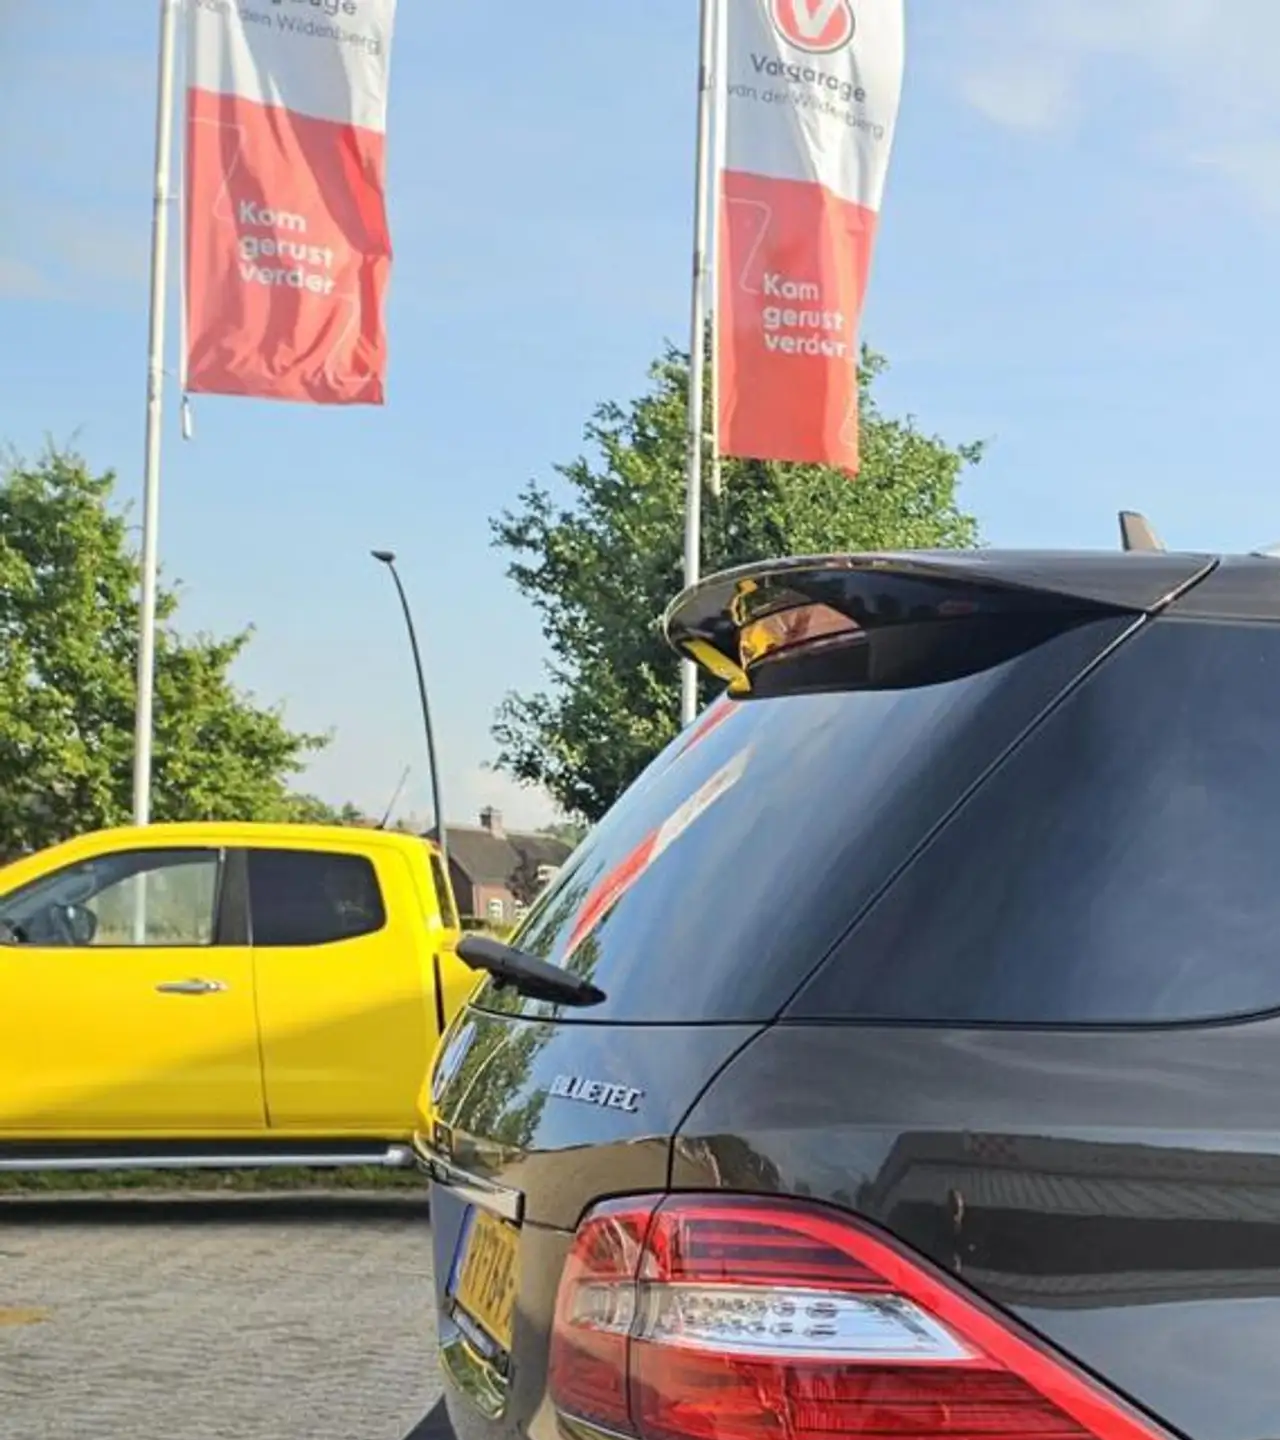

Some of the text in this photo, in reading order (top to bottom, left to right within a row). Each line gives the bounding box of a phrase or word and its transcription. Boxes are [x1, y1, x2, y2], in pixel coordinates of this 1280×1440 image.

[751, 53, 866, 103] Vakgarage
[240, 199, 306, 233] Kom
[240, 236, 333, 269] gerust
[239, 260, 335, 295] verder
[764, 272, 820, 301] Kom
[763, 307, 844, 331] gerust
[764, 332, 848, 357] verder
[549, 1076, 644, 1113] BLUETEC
